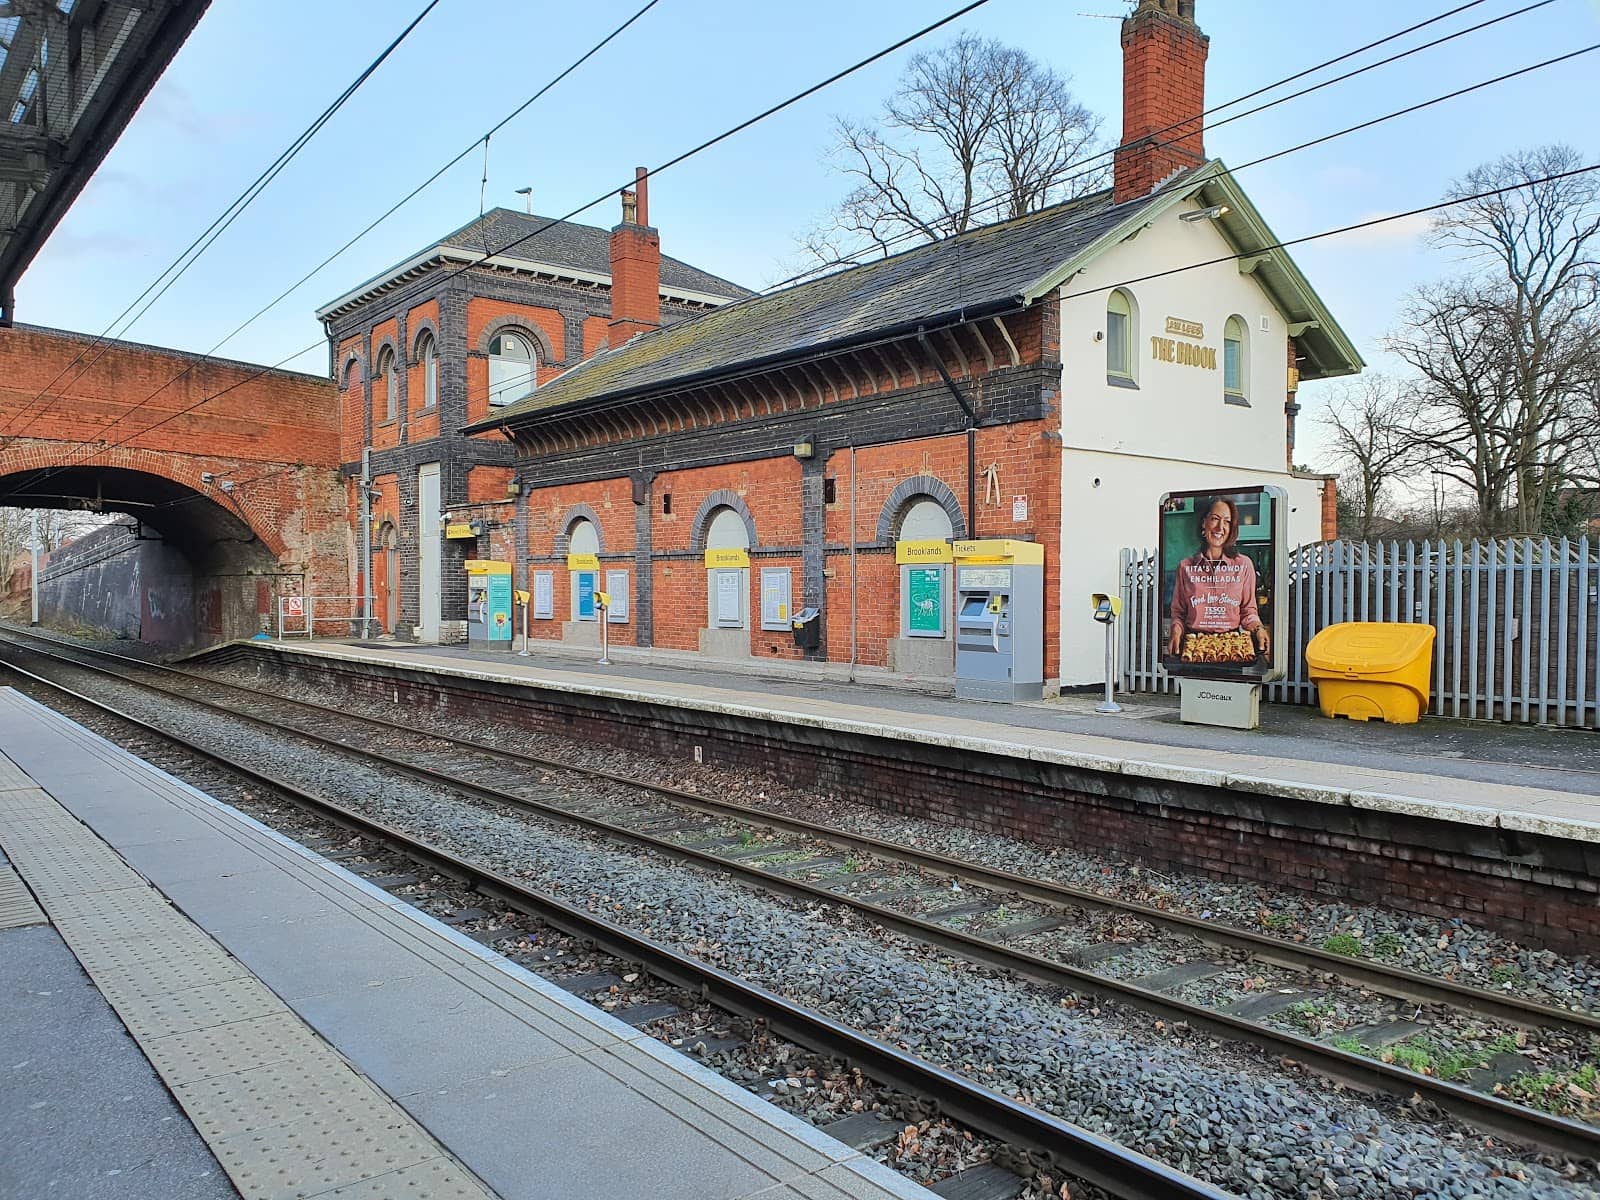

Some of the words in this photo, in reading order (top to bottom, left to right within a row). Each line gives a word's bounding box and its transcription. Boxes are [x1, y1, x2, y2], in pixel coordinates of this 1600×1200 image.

[1151, 336, 1175, 362] THE
[1177, 341, 1216, 370] BROOK
[907, 546, 942, 556] Brooklands
[954, 544, 976, 553] Tickets
[1185, 565, 1210, 573] RITA'S
[1190, 575, 1241, 583] ENCHILADAS
[1190, 594, 1206, 608] Food
[1197, 691, 1232, 701] JCDecaux
